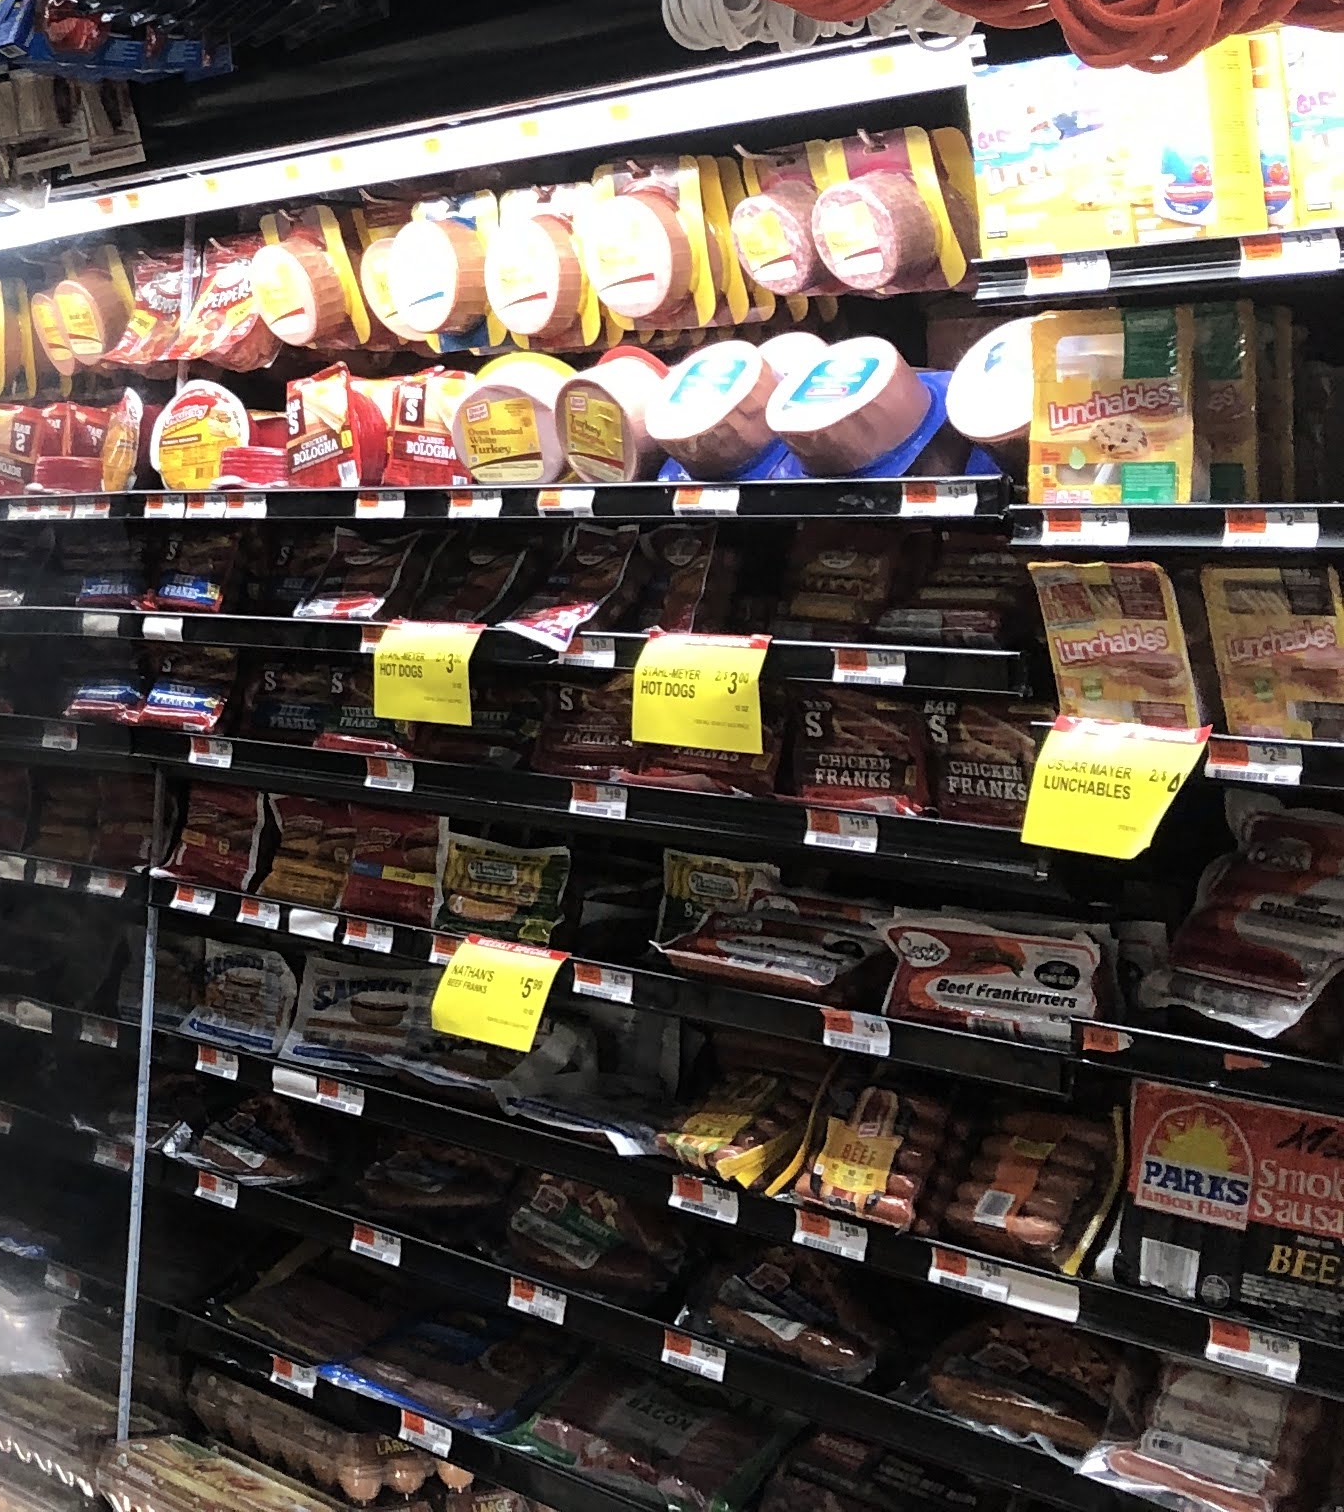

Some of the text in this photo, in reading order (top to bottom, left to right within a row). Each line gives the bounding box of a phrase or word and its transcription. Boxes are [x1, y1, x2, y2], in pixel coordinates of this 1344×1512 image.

[404, 398, 419, 423] S
[1049, 384, 1175, 430] Lunchables
[287, 412, 301, 436] S
[292, 439, 340, 466] BOLOGNA
[405, 441, 457, 461] BOLOGNA
[471, 443, 512, 455] Turkey
[1057, 625, 1168, 664] Lunchables
[1229, 622, 1336, 662] Lunchables
[264, 671, 277, 692] S
[380, 663, 423, 678] HOT DOGS
[331, 672, 344, 694] S
[641, 679, 696, 699] HOT DOGS
[805, 710, 825, 739] S
[928, 714, 949, 744] S
[818, 753, 892, 772] CHICKEN
[948, 760, 1024, 782] CHICKEN
[1089, 763, 1132, 780] MAYER
[814, 767, 892, 790] FRANKS
[945, 775, 1028, 802] FRANKS
[1043, 774, 1131, 801] LUNCHABLES
[514, 945, 552, 958] SPECIAL
[451, 964, 495, 983] NATHAN'S
[936, 977, 1078, 1009] Beef Frankfurters
[840, 1143, 876, 1165] BEEF
[1142, 1159, 1249, 1207] PARKS
[1258, 1158, 1344, 1200] Smok
[1253, 1191, 1344, 1234] Sausa
[1267, 1243, 1344, 1286] BEE
[625, 1397, 693, 1433] BACON
[376, 1437, 415, 1456] LARG
